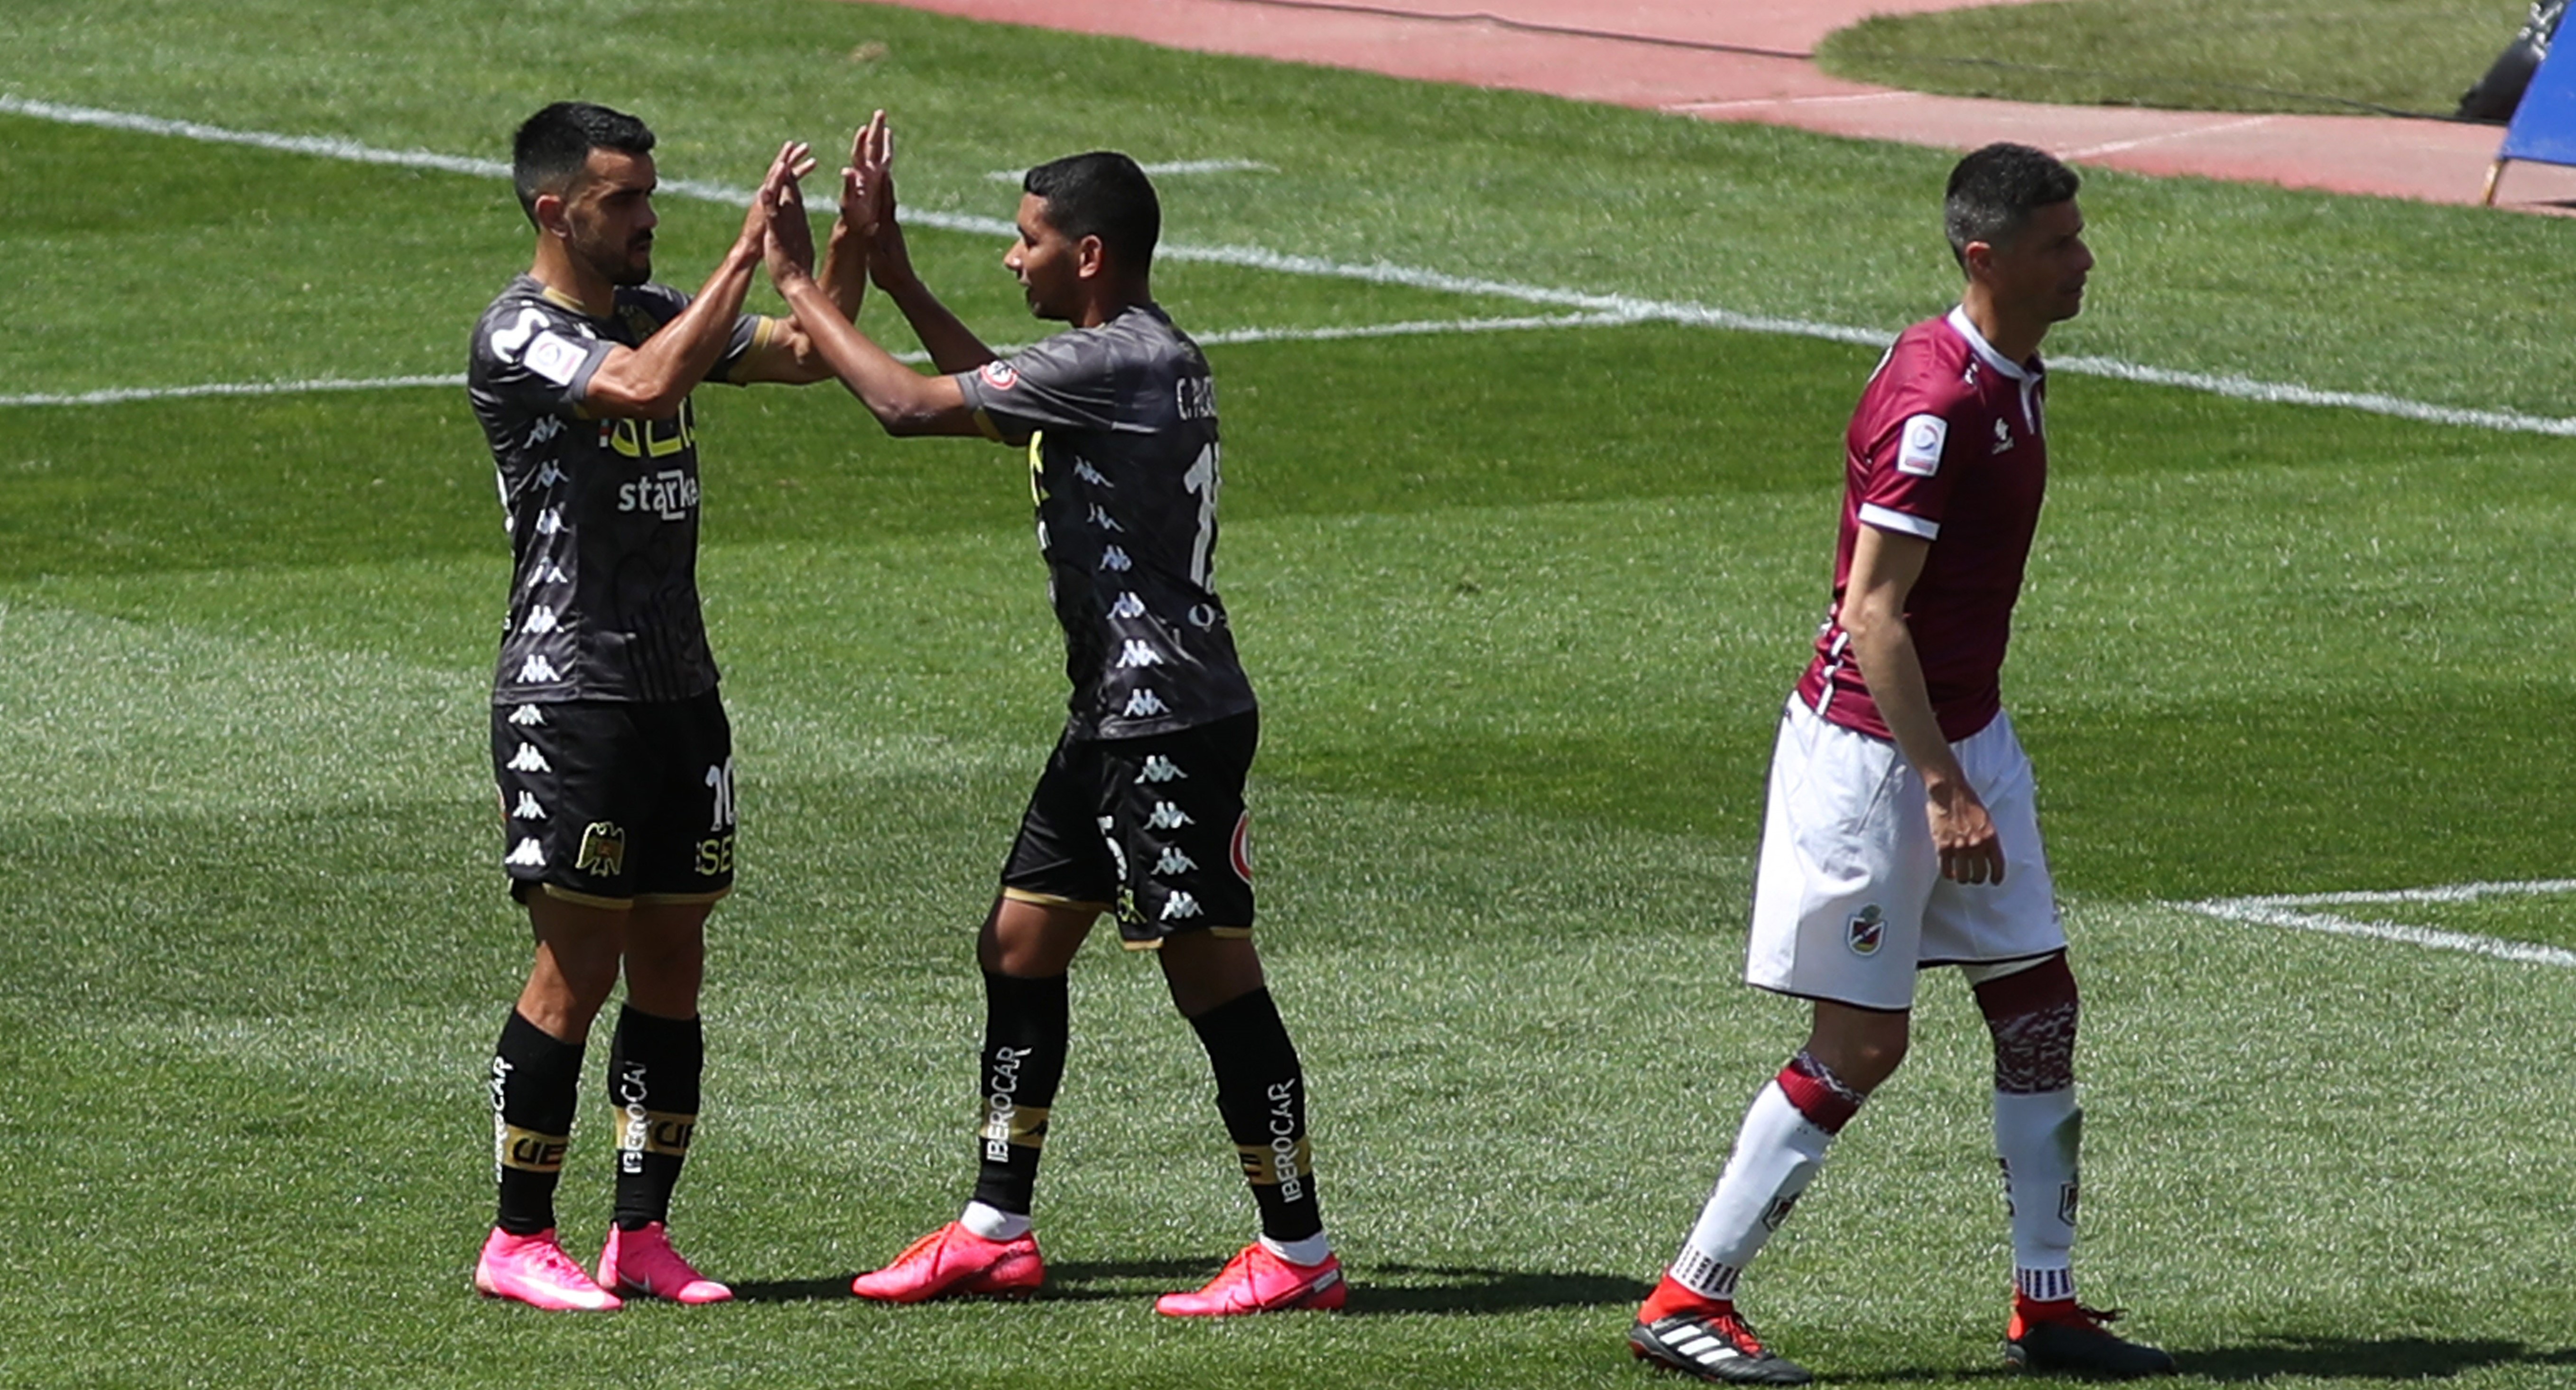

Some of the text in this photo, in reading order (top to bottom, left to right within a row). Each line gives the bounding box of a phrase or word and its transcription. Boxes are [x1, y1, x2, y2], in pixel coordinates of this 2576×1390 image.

[1184, 442, 1222, 595] 1
[987, 1046, 1033, 1163] IBEROCAR
[1268, 1078, 1303, 1203] IBEROCAR
